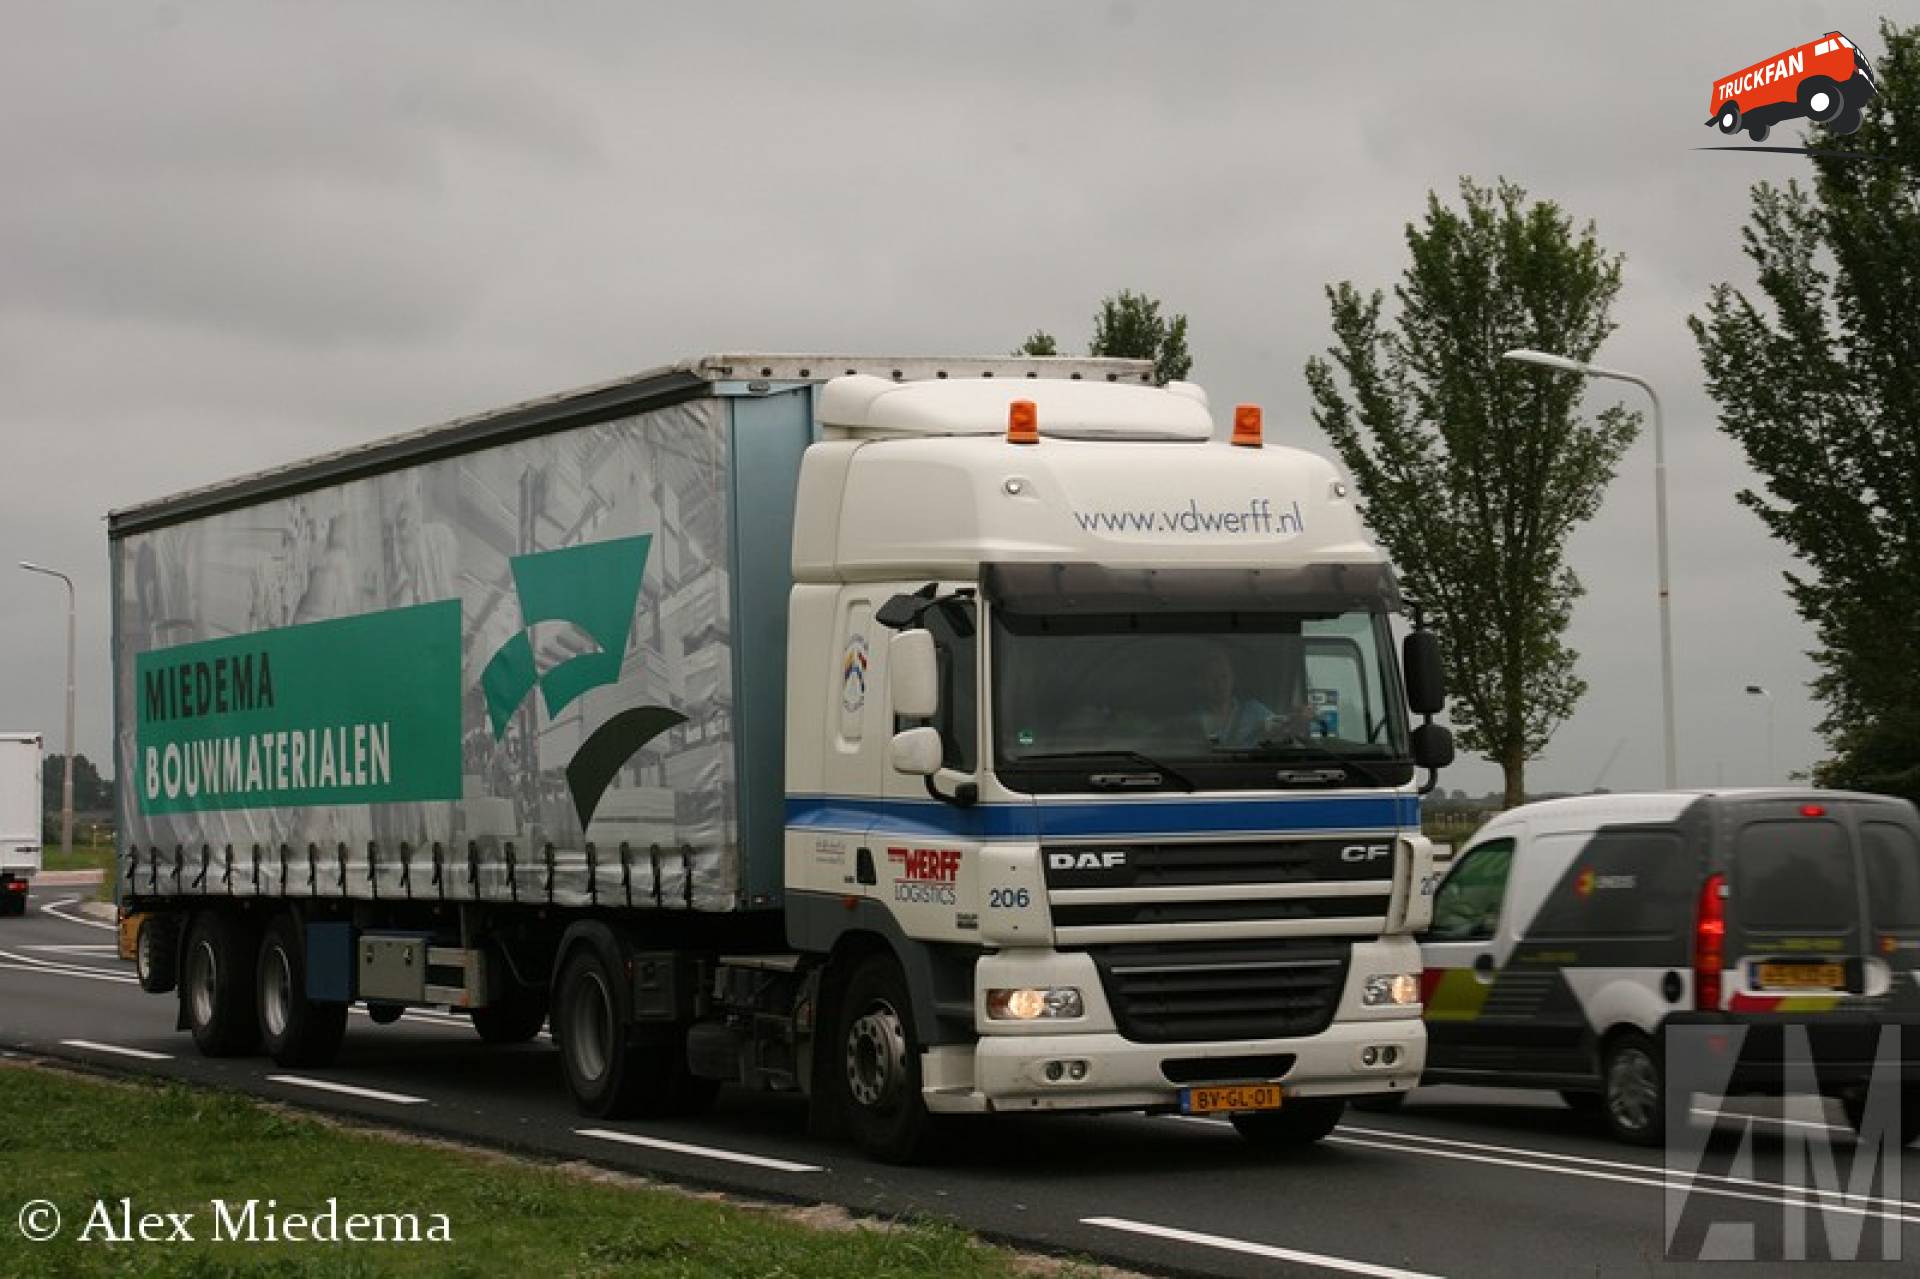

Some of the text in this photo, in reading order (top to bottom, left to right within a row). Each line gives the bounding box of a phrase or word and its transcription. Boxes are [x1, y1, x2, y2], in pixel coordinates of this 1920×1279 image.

[1074, 498, 1304, 533] www.vdwerff.nl
[145, 652, 275, 721] MIEDEMA
[145, 721, 391, 800] BOUWMATERIALEN
[905, 848, 962, 881] WERFF
[1048, 851, 1127, 870] DAF
[1341, 845, 1391, 862] CF
[895, 884, 956, 905] LOGISTICS
[990, 887, 1030, 908] 206
[1197, 1088, 1274, 1110] BV-GL-01
